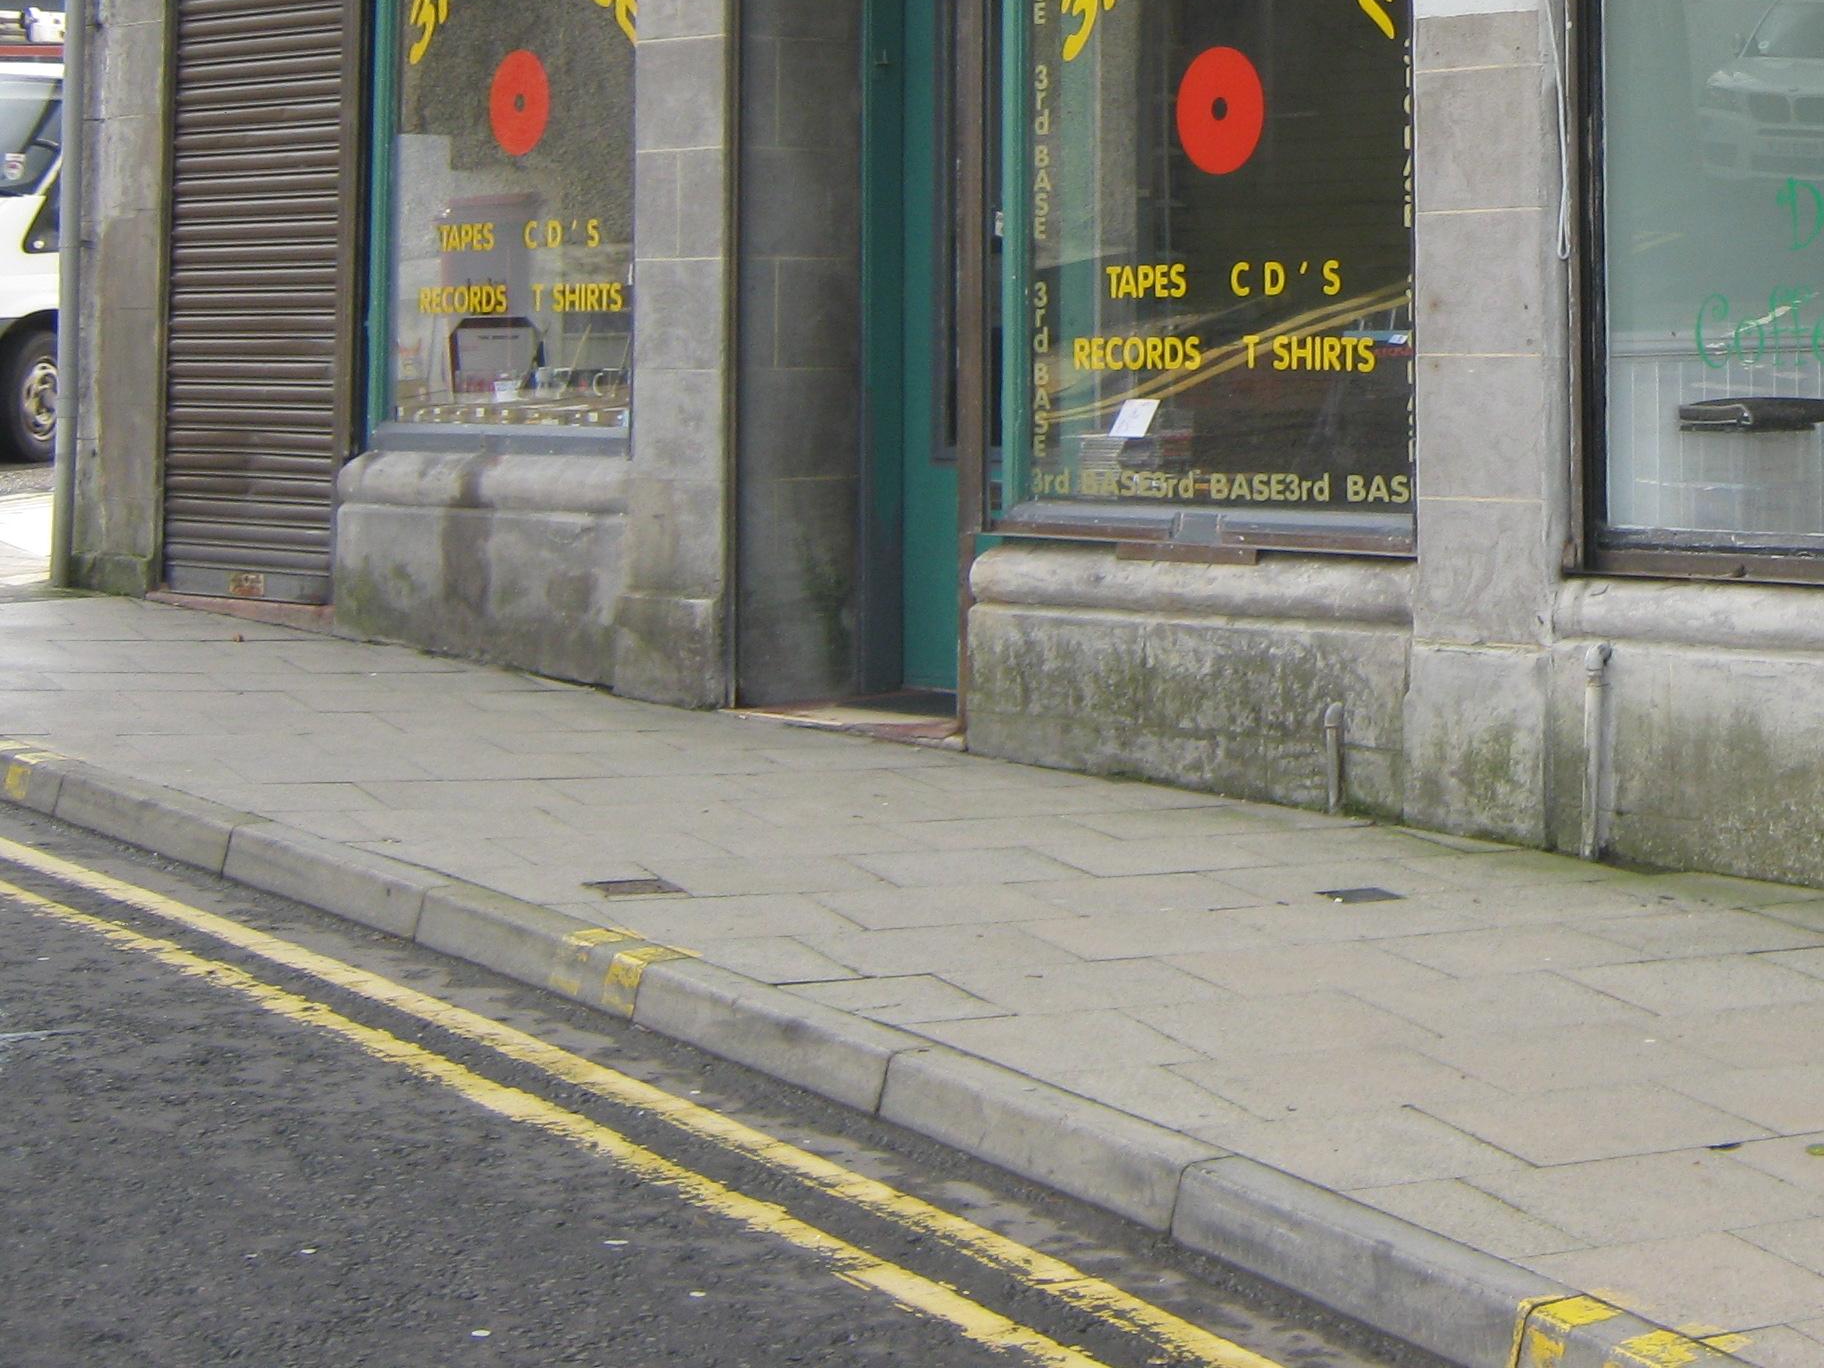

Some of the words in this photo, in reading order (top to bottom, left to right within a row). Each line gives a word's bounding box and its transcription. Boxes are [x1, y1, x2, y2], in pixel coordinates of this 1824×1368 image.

[437, 222, 495, 252] TAPES
[1105, 263, 1188, 299] TAPES
[418, 285, 509, 314] RECORDS
[532, 284, 544, 313] T
[551, 282, 625, 313] SHIRTS
[1073, 335, 1202, 372] RECORDS
[1243, 336, 1260, 368] T
[1272, 336, 1377, 373] SHIRTS
[1345, 474, 1413, 504] BAS
